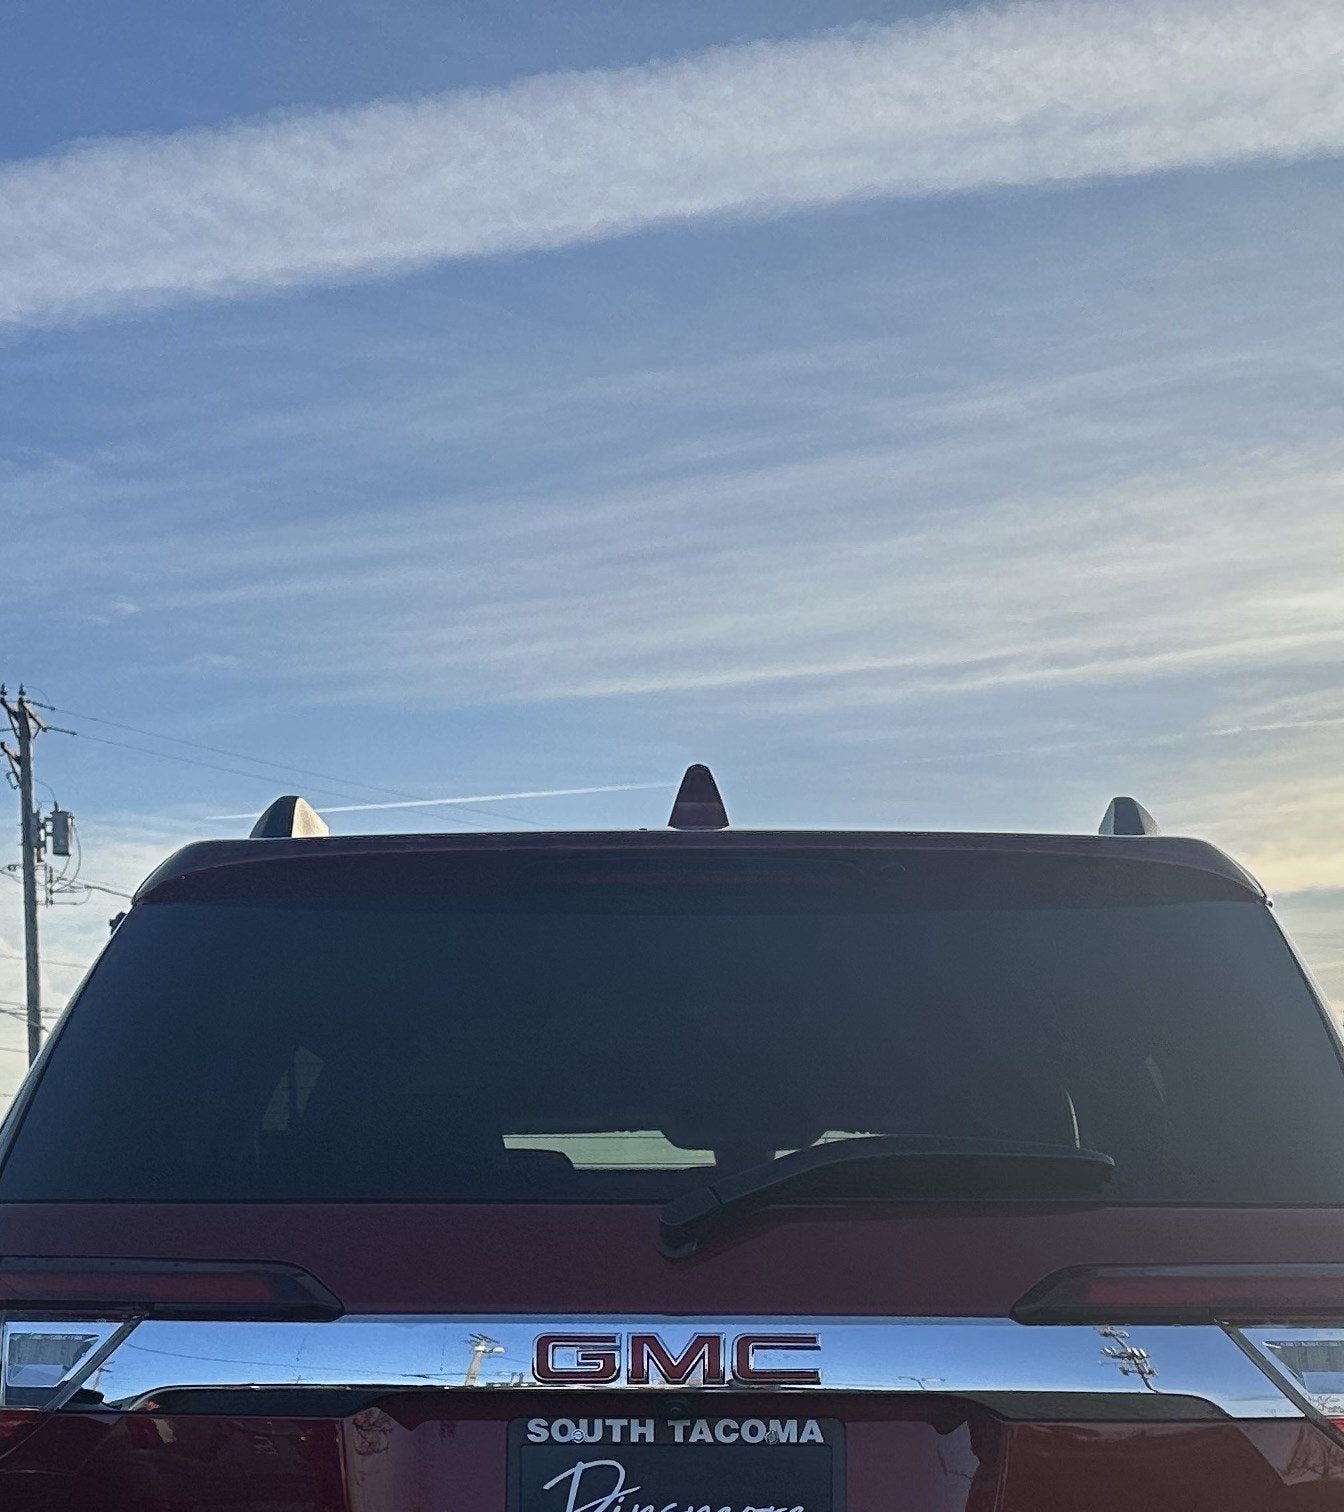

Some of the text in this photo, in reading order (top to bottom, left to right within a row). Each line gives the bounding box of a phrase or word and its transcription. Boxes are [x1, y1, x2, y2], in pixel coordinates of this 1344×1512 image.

[532, 1332, 822, 1386] GMC
[527, 1418, 825, 1443] SOUTH TACOMA
